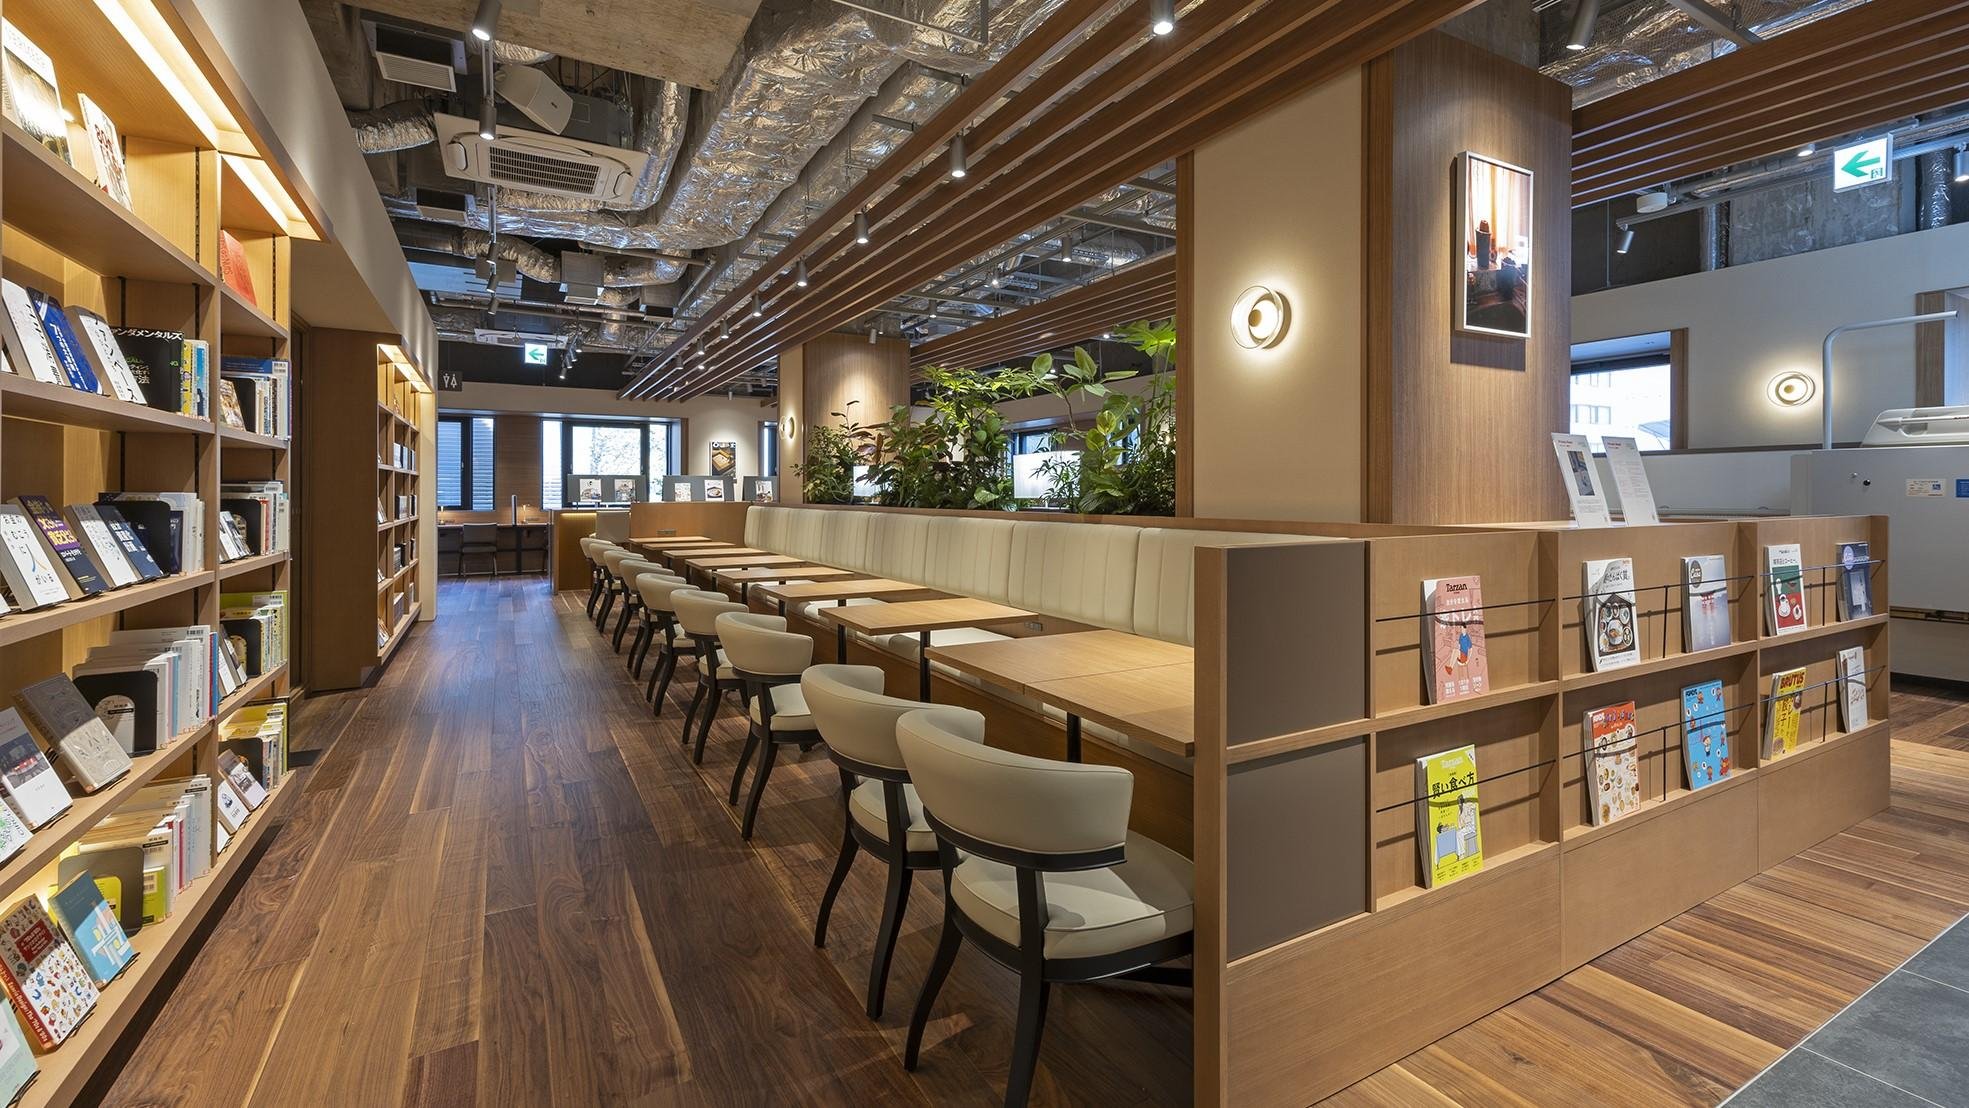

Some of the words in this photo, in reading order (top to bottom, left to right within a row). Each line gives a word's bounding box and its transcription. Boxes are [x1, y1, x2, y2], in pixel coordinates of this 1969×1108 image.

[111, 328, 184, 341] ァンダメンタルズ
[1446, 583, 1468, 593] Tarzan
[1780, 672, 1805, 690] BRUTUS
[1432, 771, 1475, 800] 賢い食べ方
